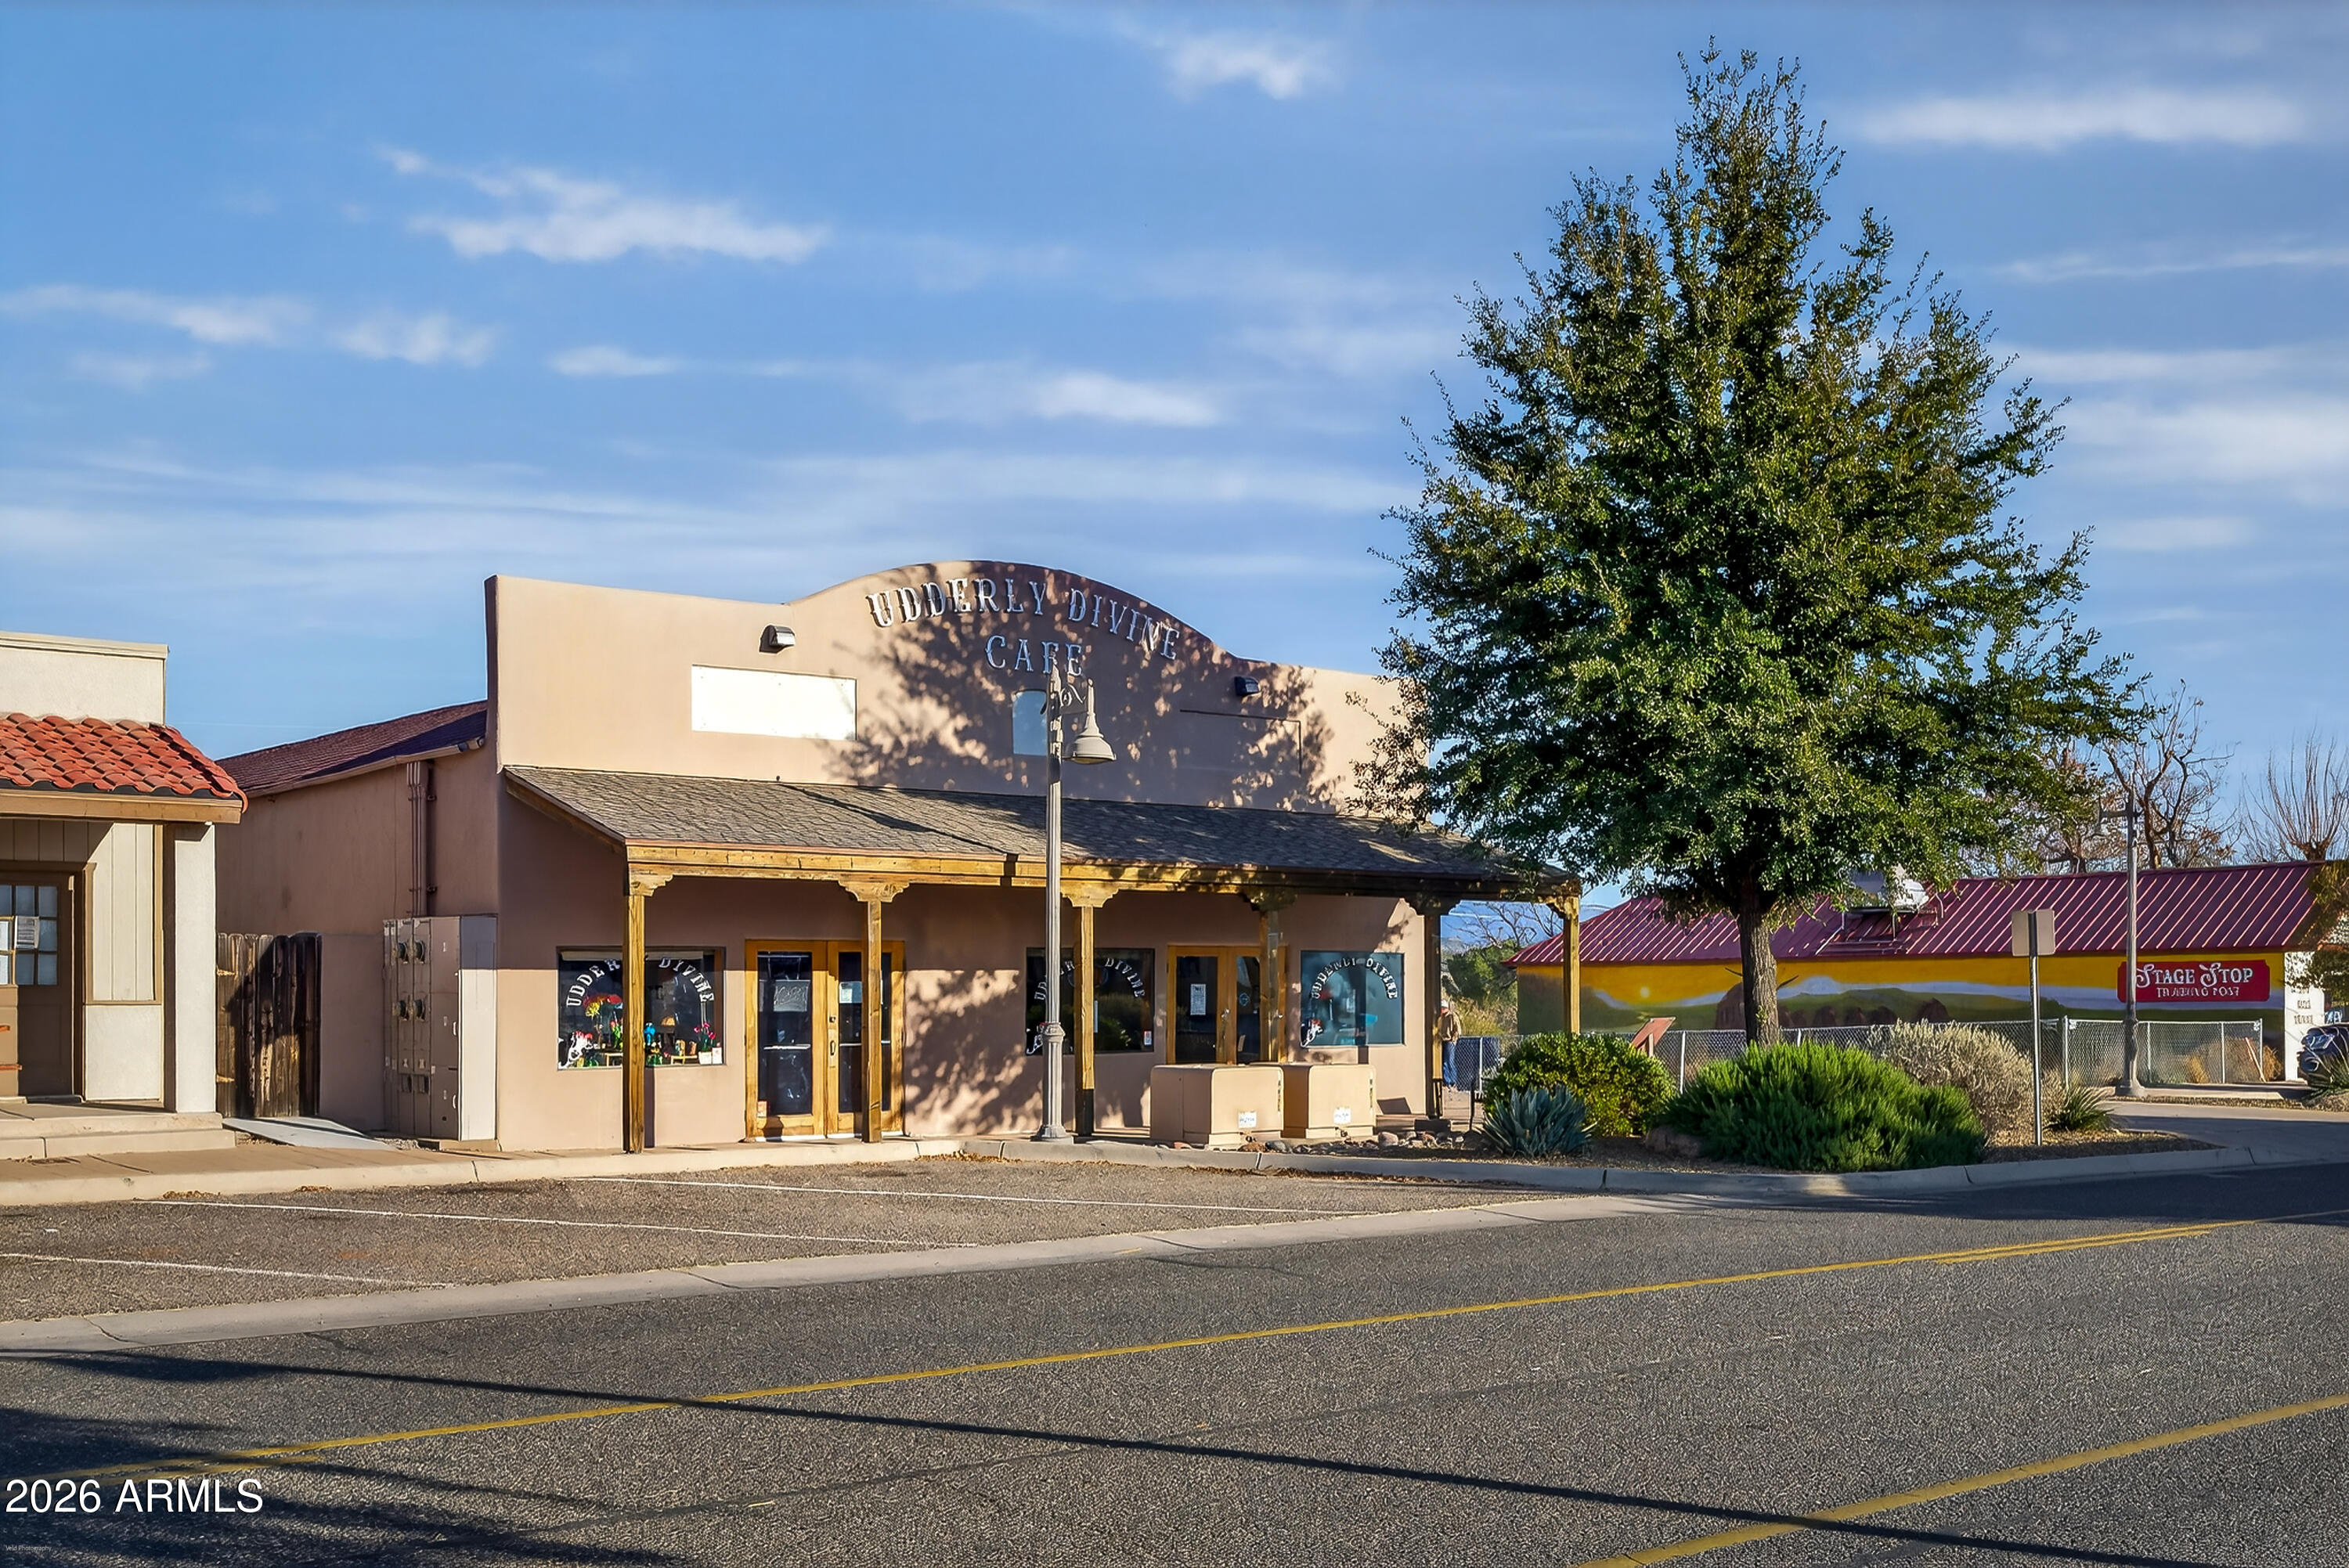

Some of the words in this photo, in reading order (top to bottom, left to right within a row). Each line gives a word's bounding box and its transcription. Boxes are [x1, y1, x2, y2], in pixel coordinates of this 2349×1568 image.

[867, 578, 1046, 627] UDDERLY
[1069, 588, 1181, 660] DIVINE
[985, 635, 1082, 676] CAFE
[659, 957, 715, 1003] DIVINE
[1105, 957, 1146, 997] DIVINE
[2136, 964, 2196, 989] STAGE
[2199, 962, 2253, 988] STOP
